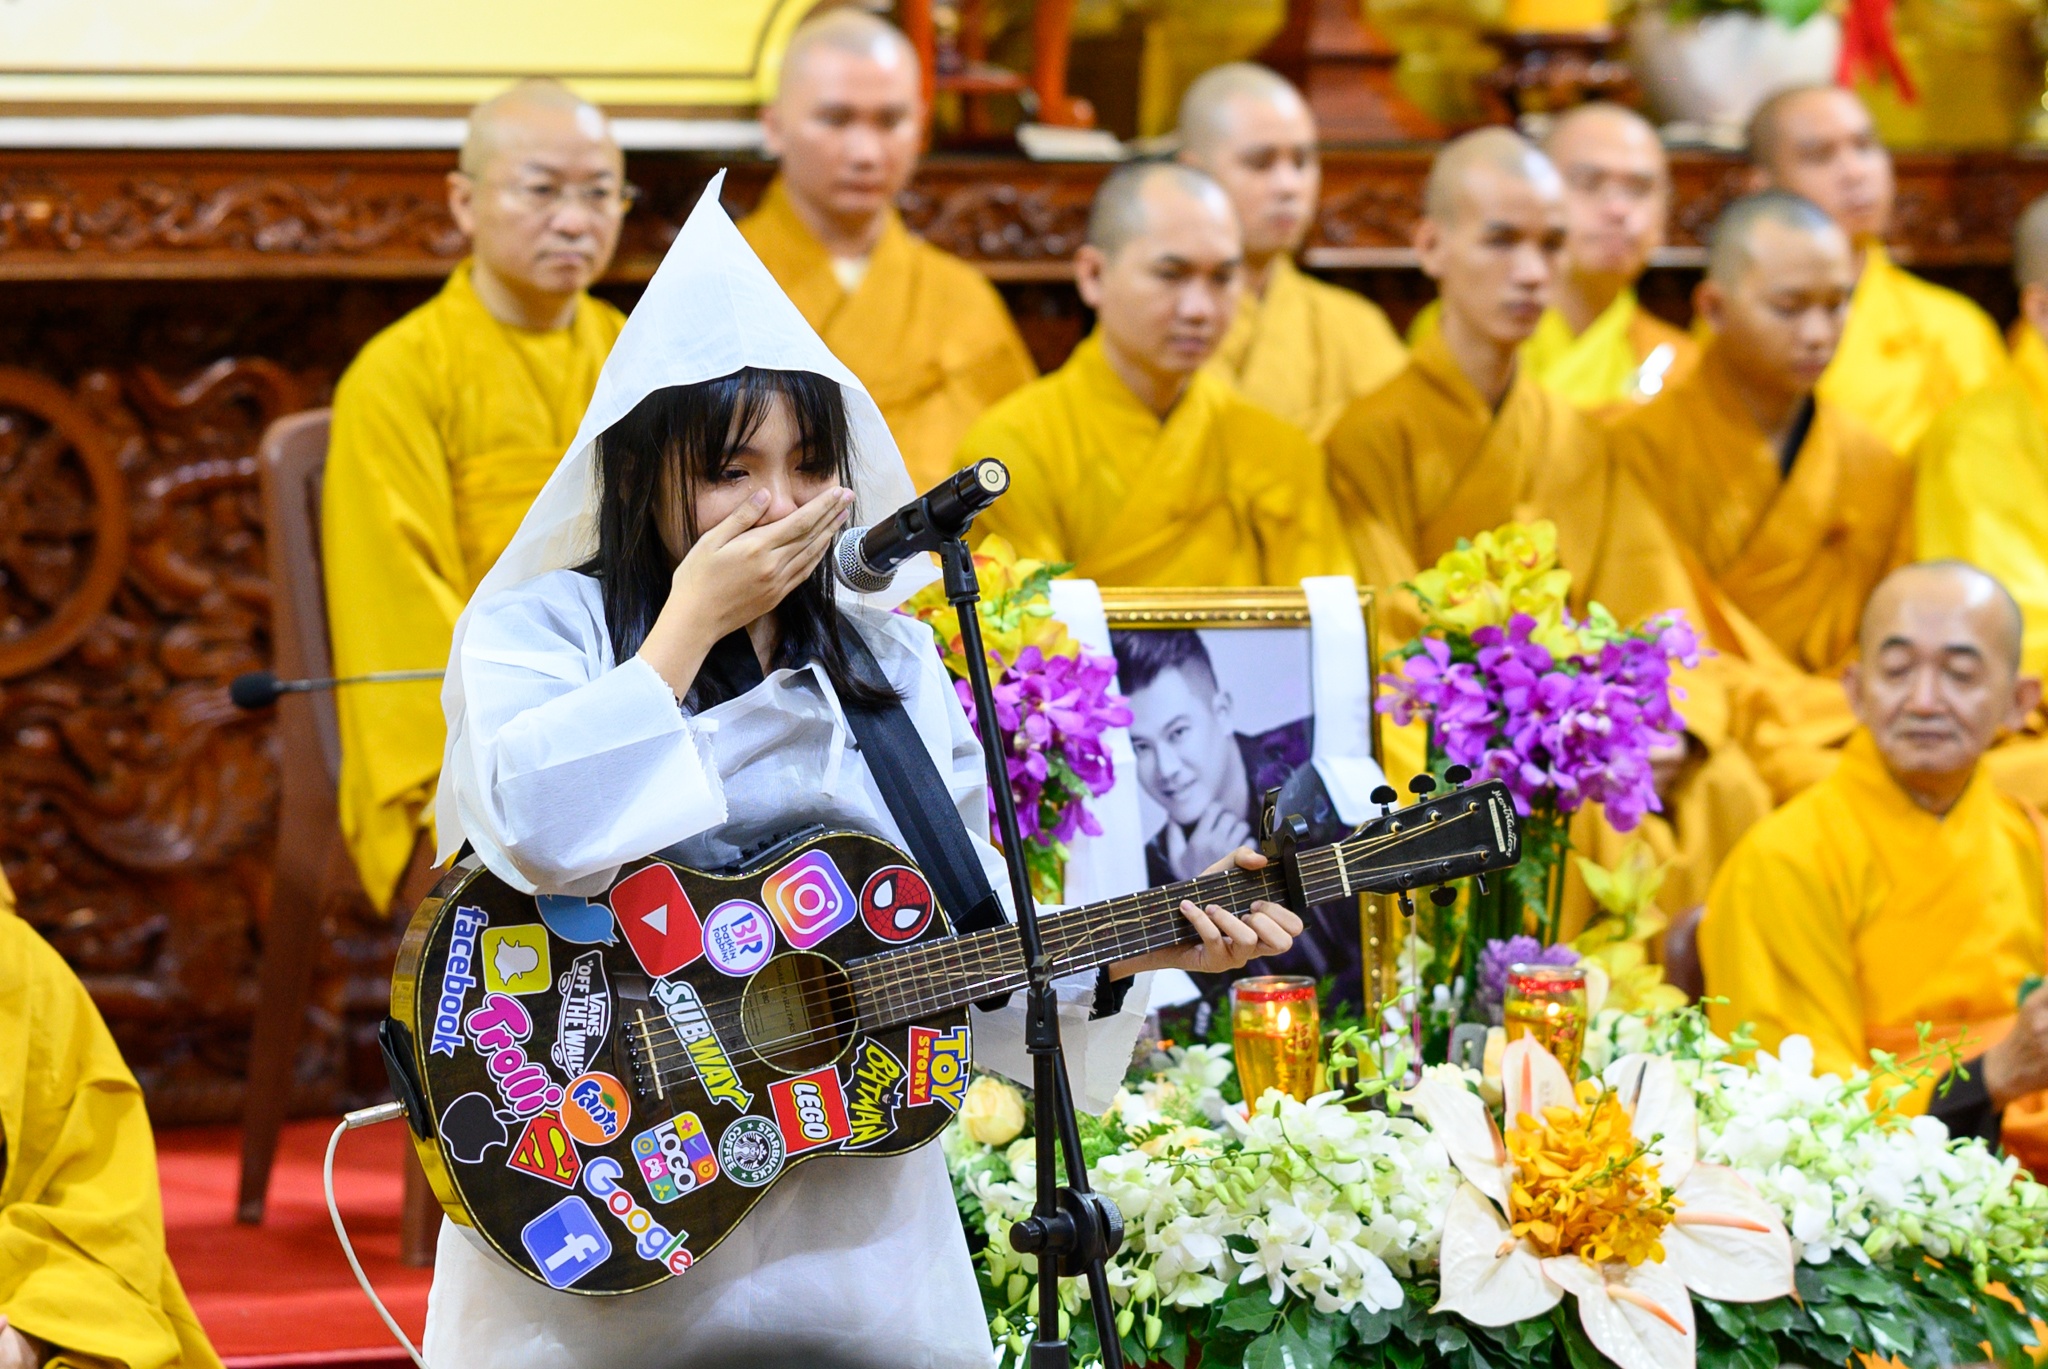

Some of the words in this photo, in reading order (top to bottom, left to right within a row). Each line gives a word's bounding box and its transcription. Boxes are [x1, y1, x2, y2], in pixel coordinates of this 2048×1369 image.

[713, 927, 730, 963] robbins
[721, 923, 737, 960] baskin
[731, 912, 763, 955] BR
[433, 906, 487, 1056] facebook
[565, 995, 589, 1028] THE
[586, 991, 607, 1037] VANS
[469, 995, 562, 1112] Trolli
[655, 979, 750, 1111] SUBWAY
[913, 1035, 931, 1099] STORY
[931, 1029, 969, 1111] TOY
[572, 1080, 618, 1137] Fanta
[793, 1081, 831, 1140] LEGO
[849, 1043, 901, 1146] BATMAN
[653, 1122, 697, 1192] LOGO
[723, 1126, 742, 1171] COFFEE
[751, 1122, 781, 1181] STARBUCKS
[585, 1158, 692, 1275] Google
